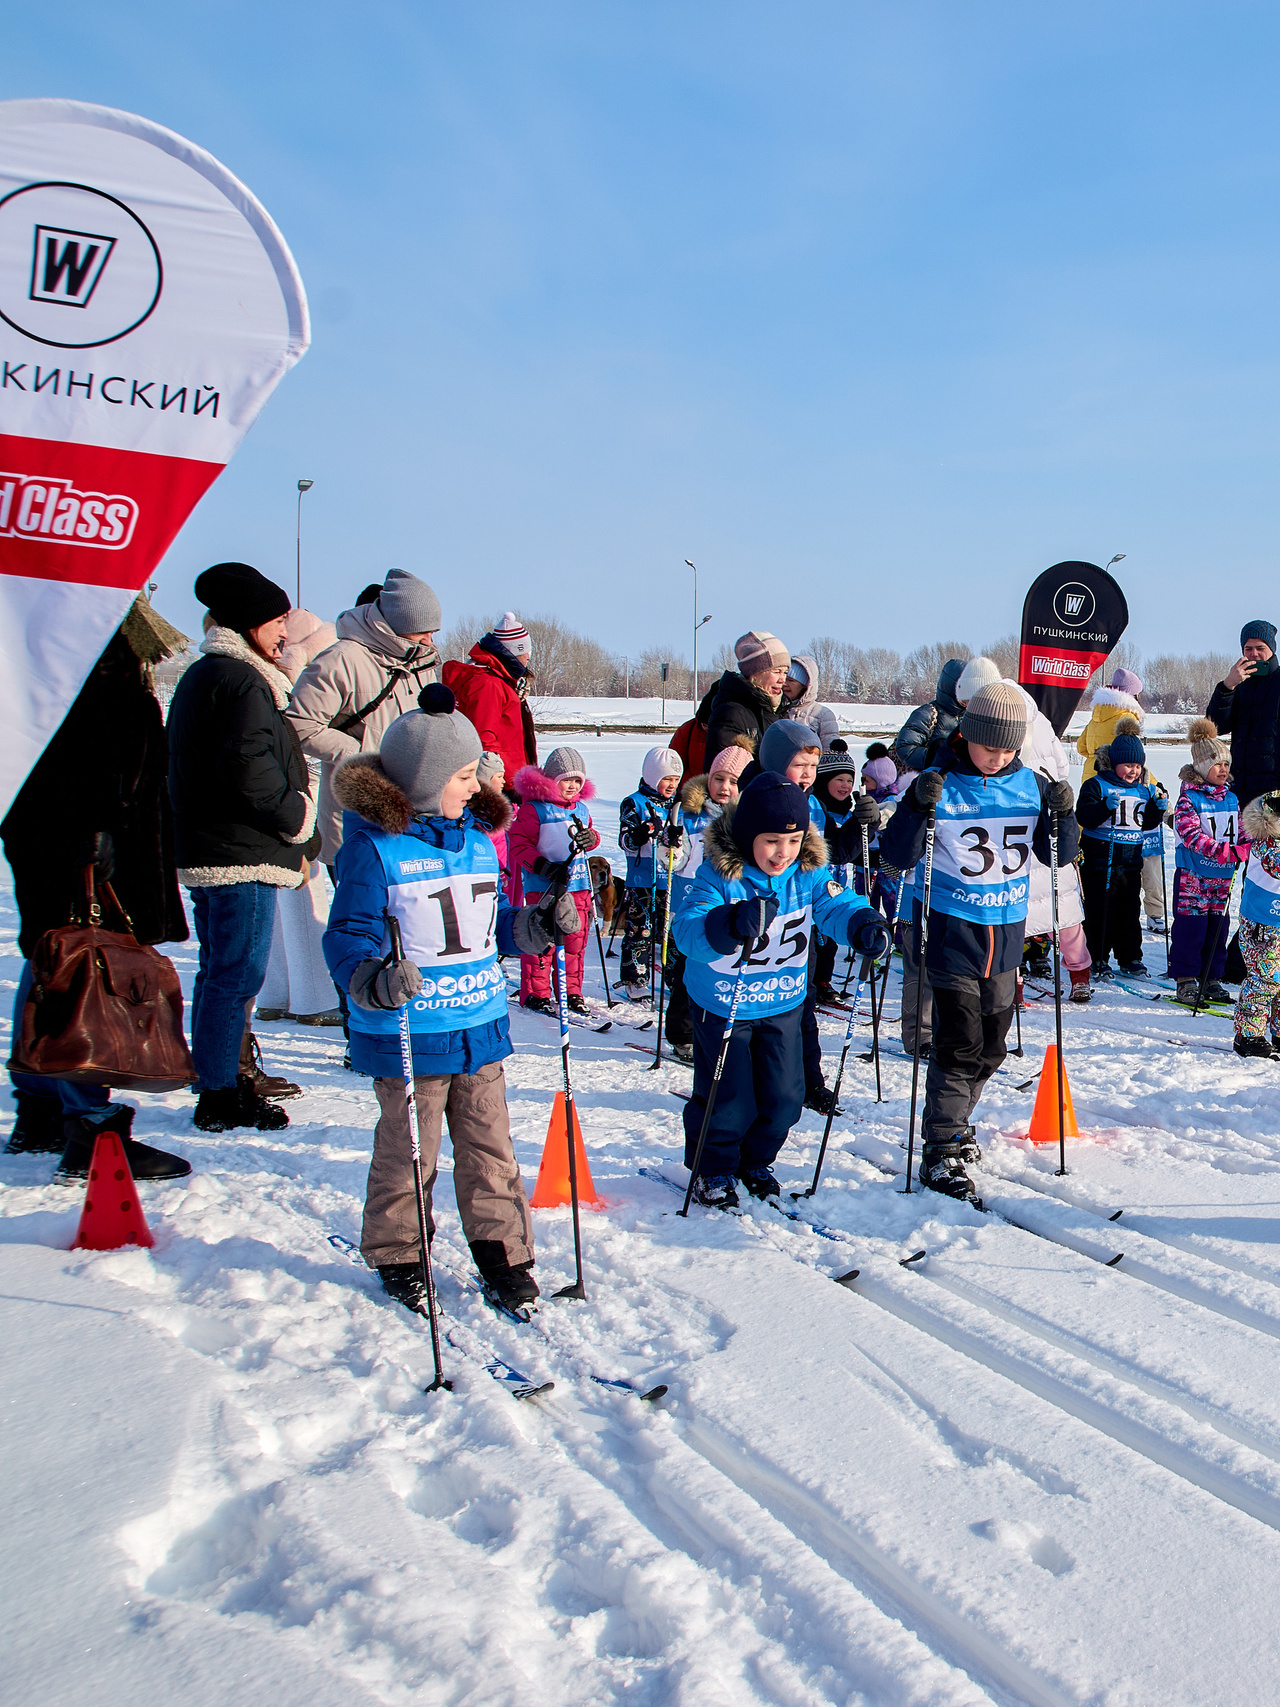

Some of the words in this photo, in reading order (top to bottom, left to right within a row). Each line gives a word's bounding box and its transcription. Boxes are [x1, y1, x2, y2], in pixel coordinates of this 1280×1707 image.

[17, 484, 130, 542] Class
[1033, 626, 1108, 643] ПУШКИНСКИЙ
[1033, 658, 1062, 675] World
[1062, 661, 1090, 678] Class
[1115, 799, 1147, 827] 16
[1206, 814, 1236, 845] 14
[401, 861, 423, 873] World
[423, 859, 444, 871] Class
[960, 826, 1029, 877] 35
[895, 880, 905, 914] NORDWAY
[427, 881, 499, 957] 17
[731, 913, 808, 969] 25
[413, 988, 488, 1011] OUTDOOR
[559, 968, 569, 1026] NORDWAY
[714, 992, 775, 1003] OUDOOR
[729, 979, 743, 1024] NORDWAY
[848, 995, 862, 1034] NORDWAY
[398, 1014, 412, 1078] NORDWAY
